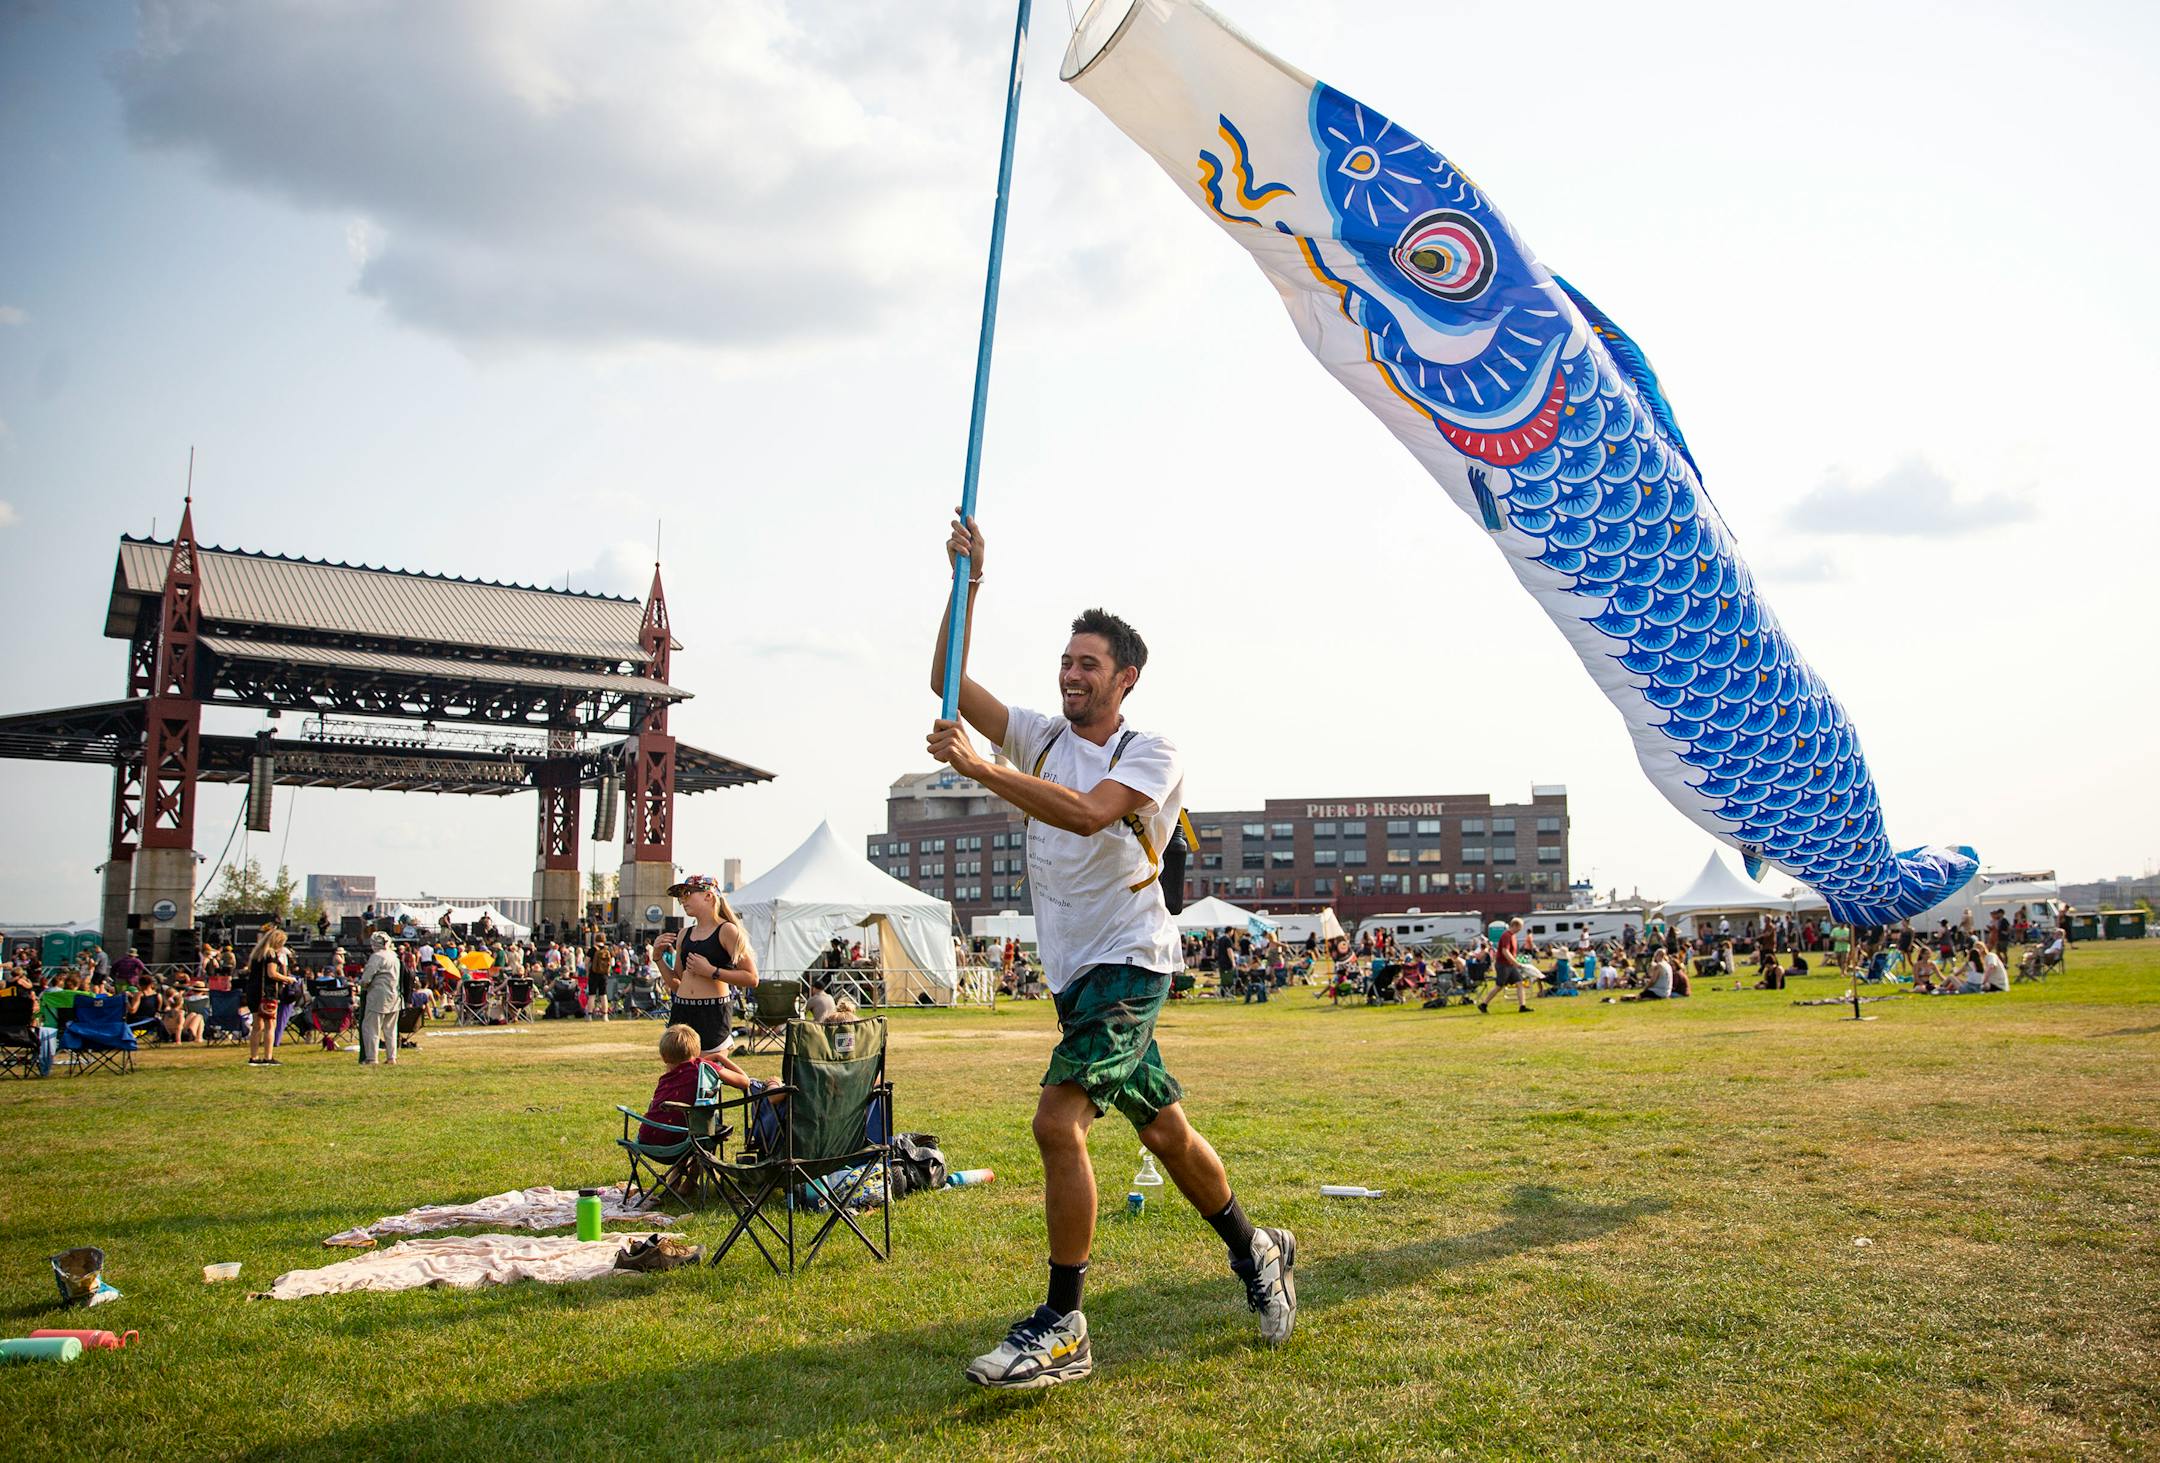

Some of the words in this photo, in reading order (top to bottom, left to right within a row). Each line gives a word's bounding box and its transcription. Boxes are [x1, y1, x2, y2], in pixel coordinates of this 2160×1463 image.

[1306, 804, 1350, 818] PIER
[1355, 803, 1368, 817] B
[1373, 802, 1445, 817] RESORT
[1998, 876, 2036, 884] CHECK
